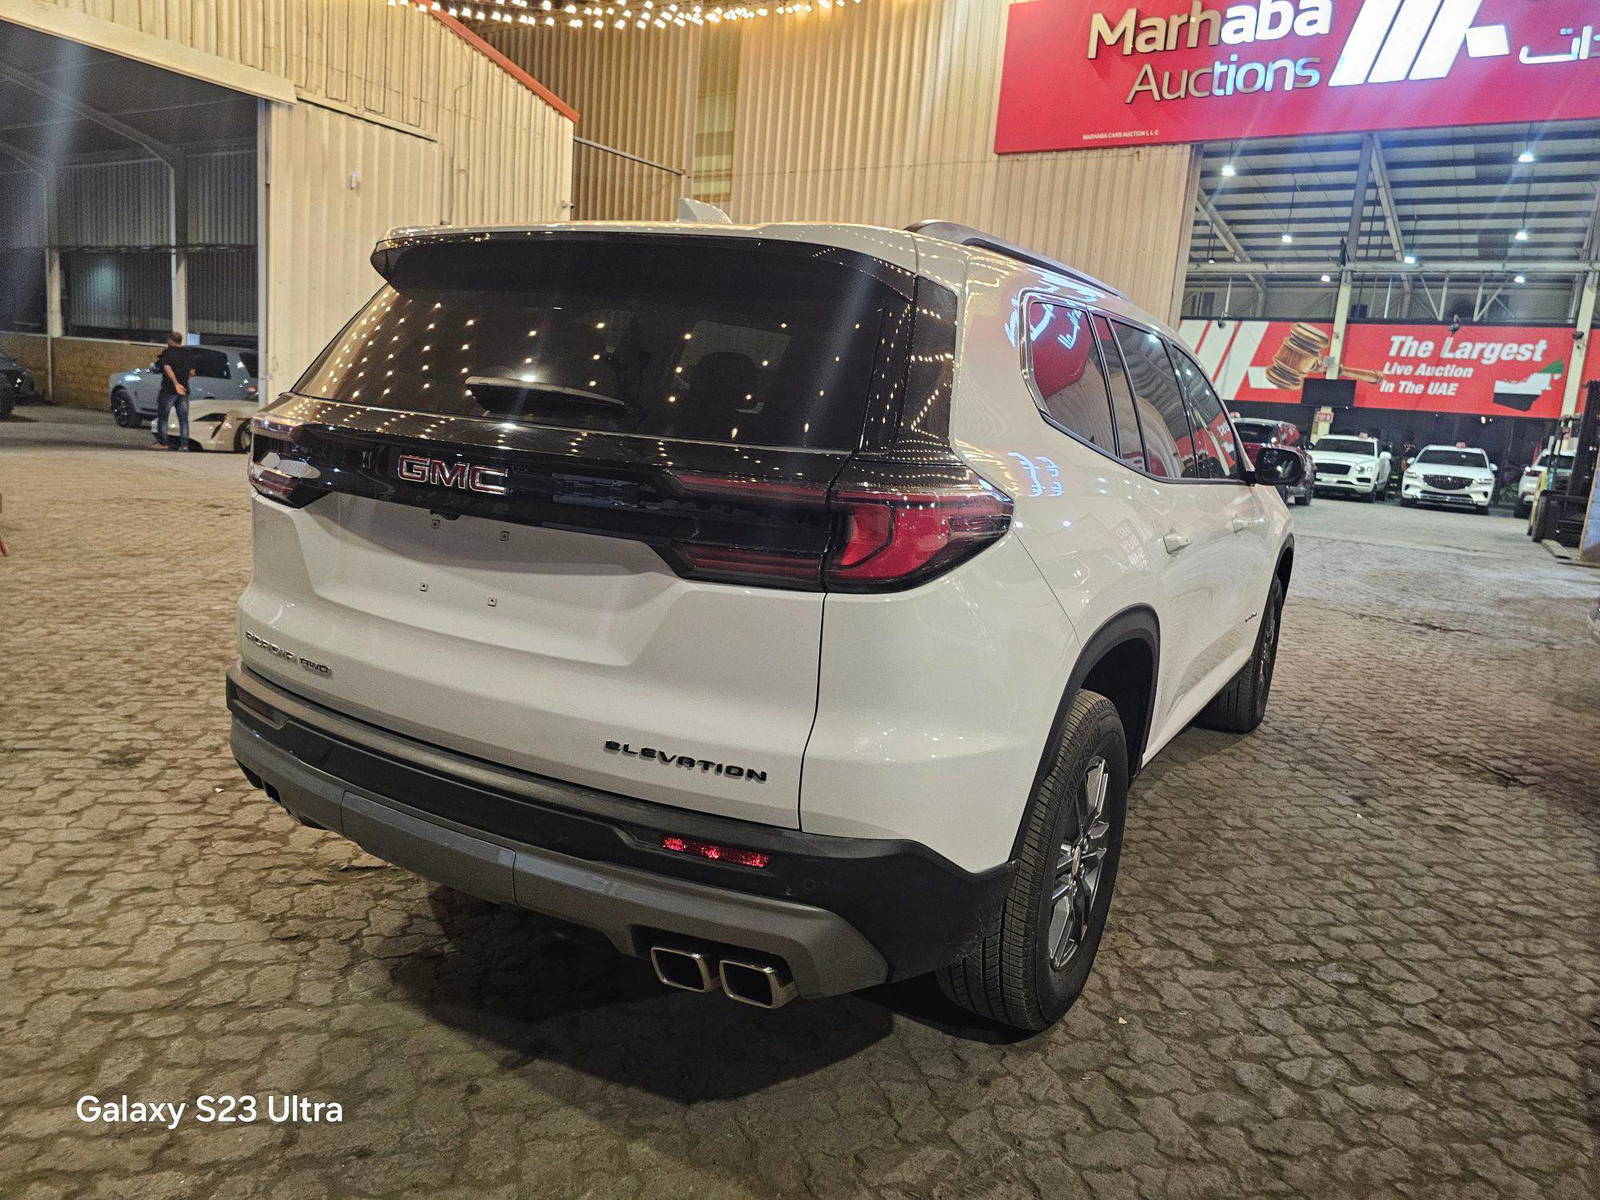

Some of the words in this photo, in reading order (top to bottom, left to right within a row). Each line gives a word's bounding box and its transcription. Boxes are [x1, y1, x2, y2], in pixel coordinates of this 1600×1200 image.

[1087, 0, 1333, 60] Marhaba
[1125, 54, 1320, 104] Auctions
[1383, 362, 1412, 376] Live
[1415, 363, 1474, 378] Auction
[1388, 335, 1434, 358] The
[1440, 336, 1548, 365] Largest
[1379, 380, 1394, 393] In
[1398, 381, 1424, 395] The
[1427, 382, 1460, 396] UAE
[397, 454, 509, 496] GMC
[604, 740, 768, 782] ELEVATION
